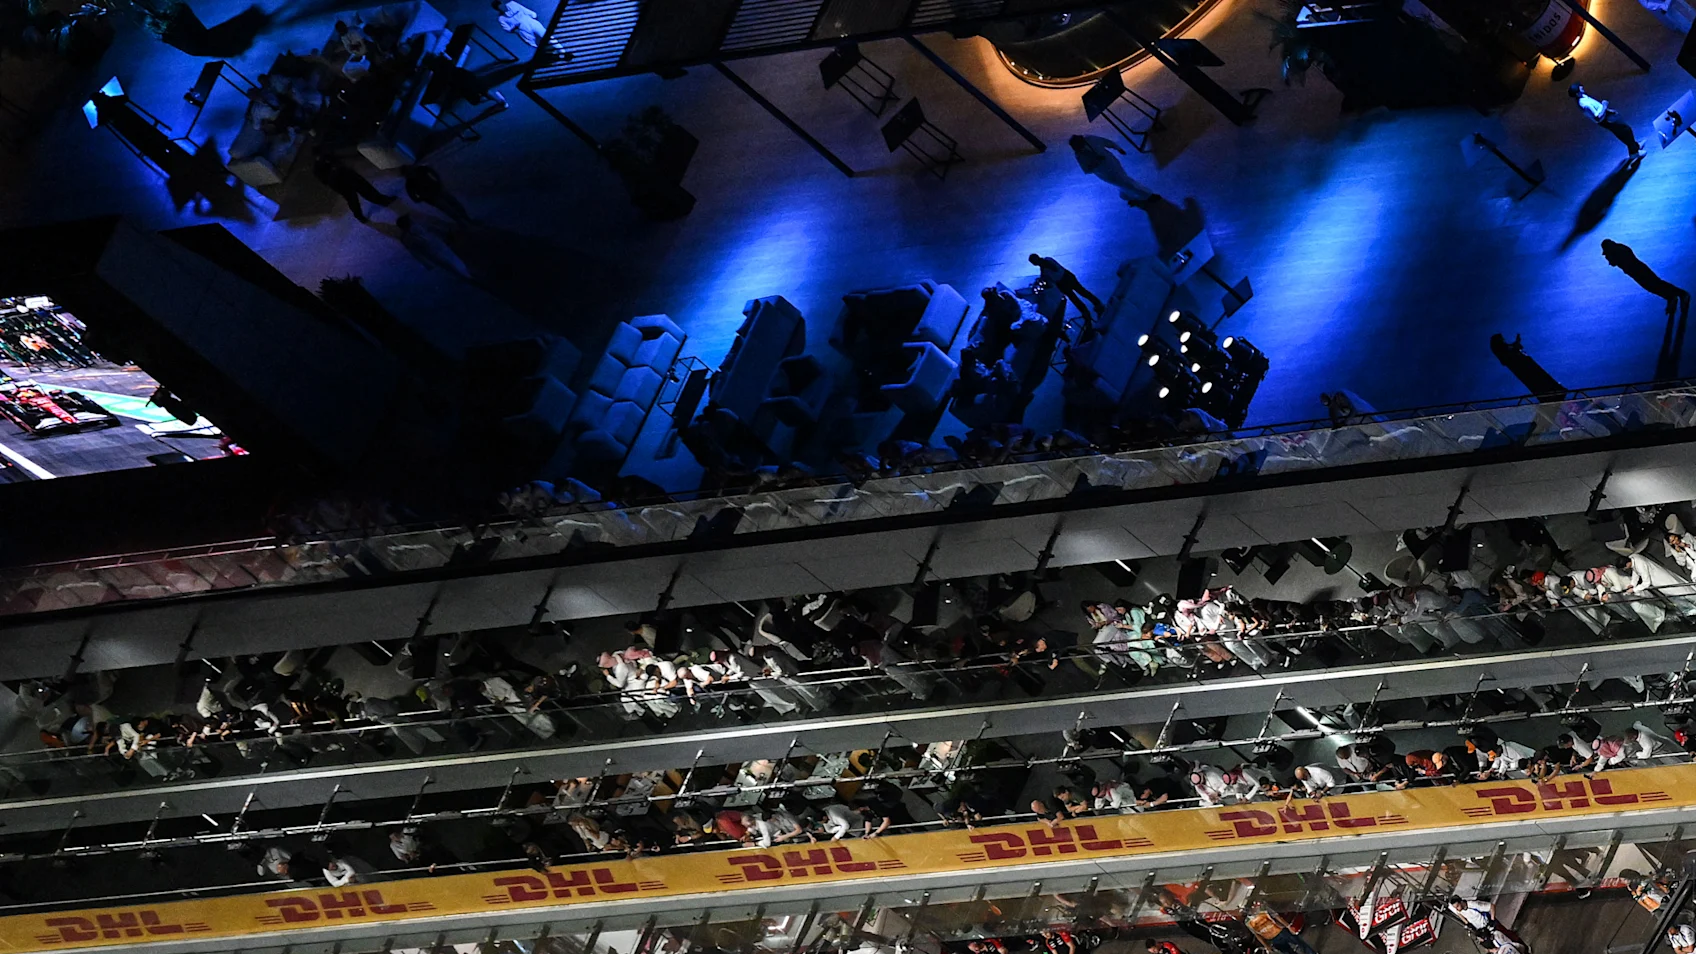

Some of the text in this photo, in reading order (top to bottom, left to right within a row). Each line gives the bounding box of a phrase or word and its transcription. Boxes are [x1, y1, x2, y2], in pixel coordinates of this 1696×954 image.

[1476, 776, 1638, 815] DHL
[1220, 802, 1377, 838] DHL
[970, 825, 1122, 861] DHL
[728, 847, 876, 881] DHL
[494, 868, 638, 902] DHL
[266, 889, 408, 922] DHL
[46, 910, 184, 942] DHL
